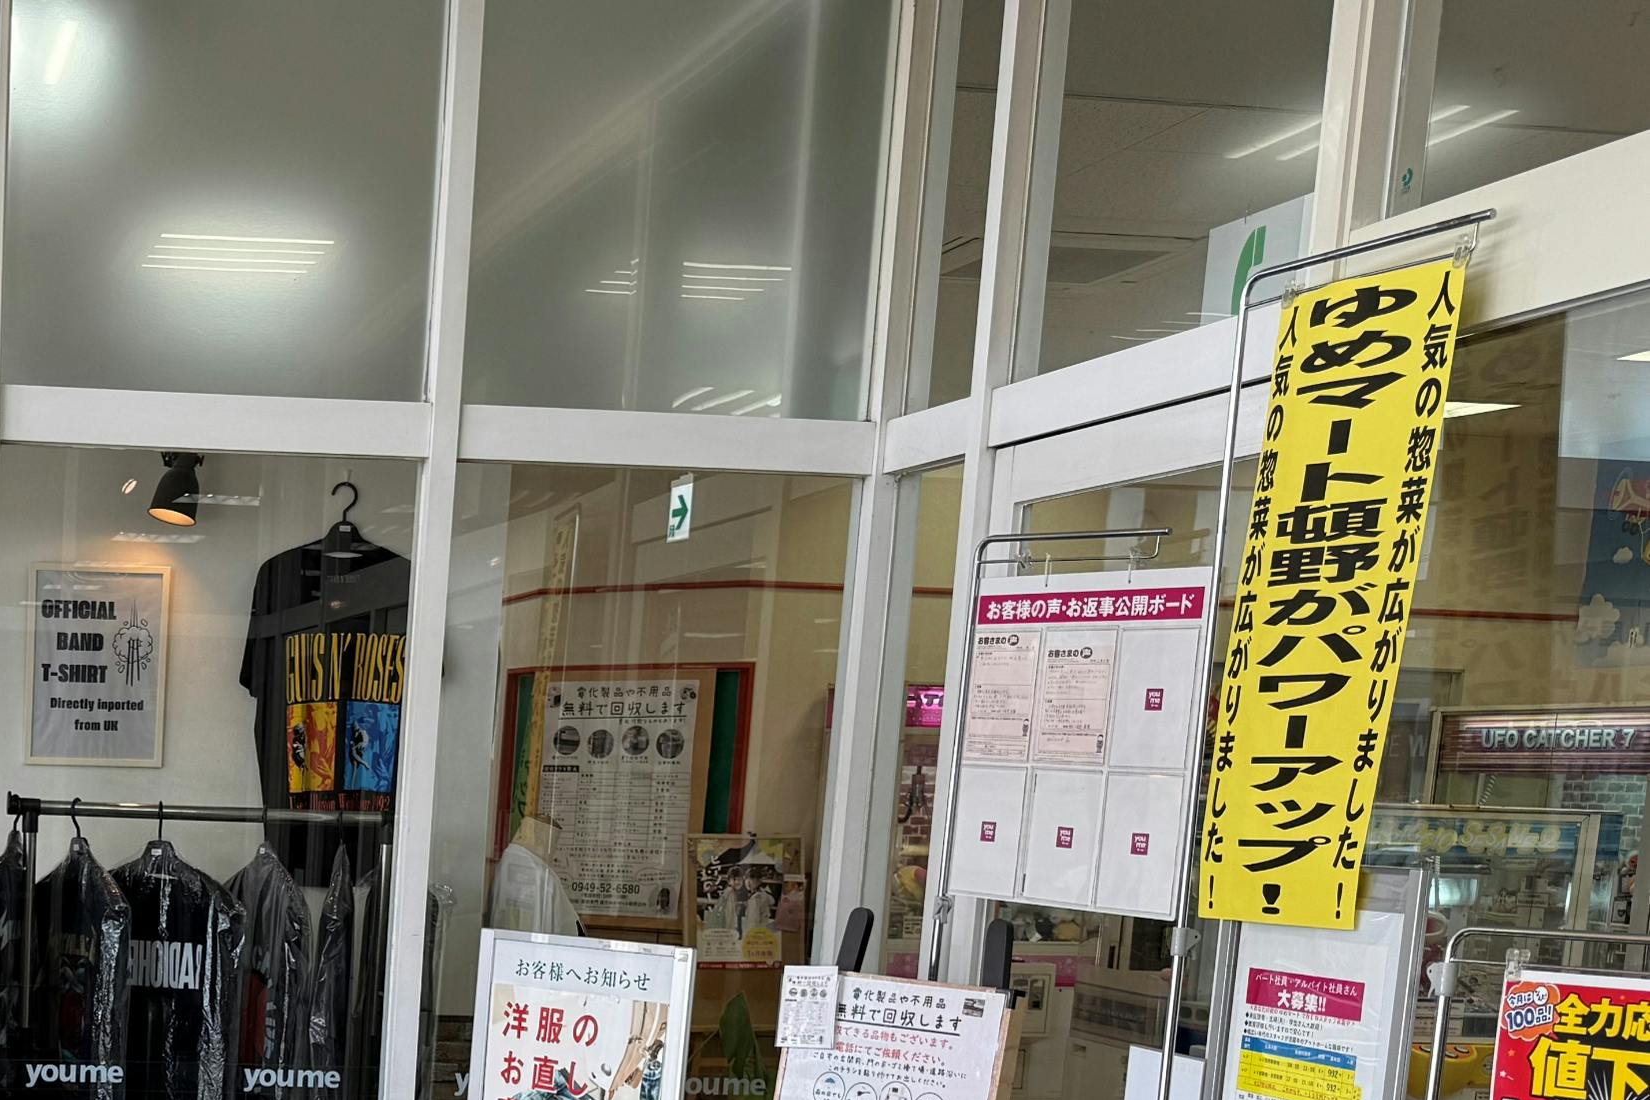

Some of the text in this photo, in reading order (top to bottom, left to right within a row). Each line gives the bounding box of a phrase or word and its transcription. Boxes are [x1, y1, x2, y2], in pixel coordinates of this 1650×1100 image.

[41, 599, 117, 621] OFFICIAL
[986, 594, 1194, 621] お客様の声・お返事公開ボード
[56, 632, 104, 652] BAND
[978, 636, 1006, 645] お客さまの
[1048, 649, 1079, 658] お客さまの
[41, 663, 108, 684] T-SHIRT
[286, 633, 325, 704] GUNS
[352, 632, 407, 704] ROSES
[50, 696, 144, 713] Directly inported
[562, 701, 686, 716] 無料で回収します
[74, 718, 118, 732] from UK
[1481, 728, 1635, 749] UFO CATCHER 7
[572, 882, 640, 894] 0949-52-6580
[515, 957, 651, 992] お客様へお知らせ
[1255, 973, 1357, 996] パート社員・アルバイト社員さん
[853, 987, 946, 1009] 電化製品や不用品
[1277, 989, 1326, 1012] 大募集!!
[1507, 991, 1534, 1008] 今月は
[502, 1001, 599, 1048] 洋服の
[838, 1003, 962, 1031] 無料で回収します
[1505, 1005, 1553, 1031] 100品!
[25, 1061, 124, 1088] youme
[243, 1065, 340, 1092] youme
[500, 1049, 588, 1097] お直し
[685, 1074, 766, 1097] oume
